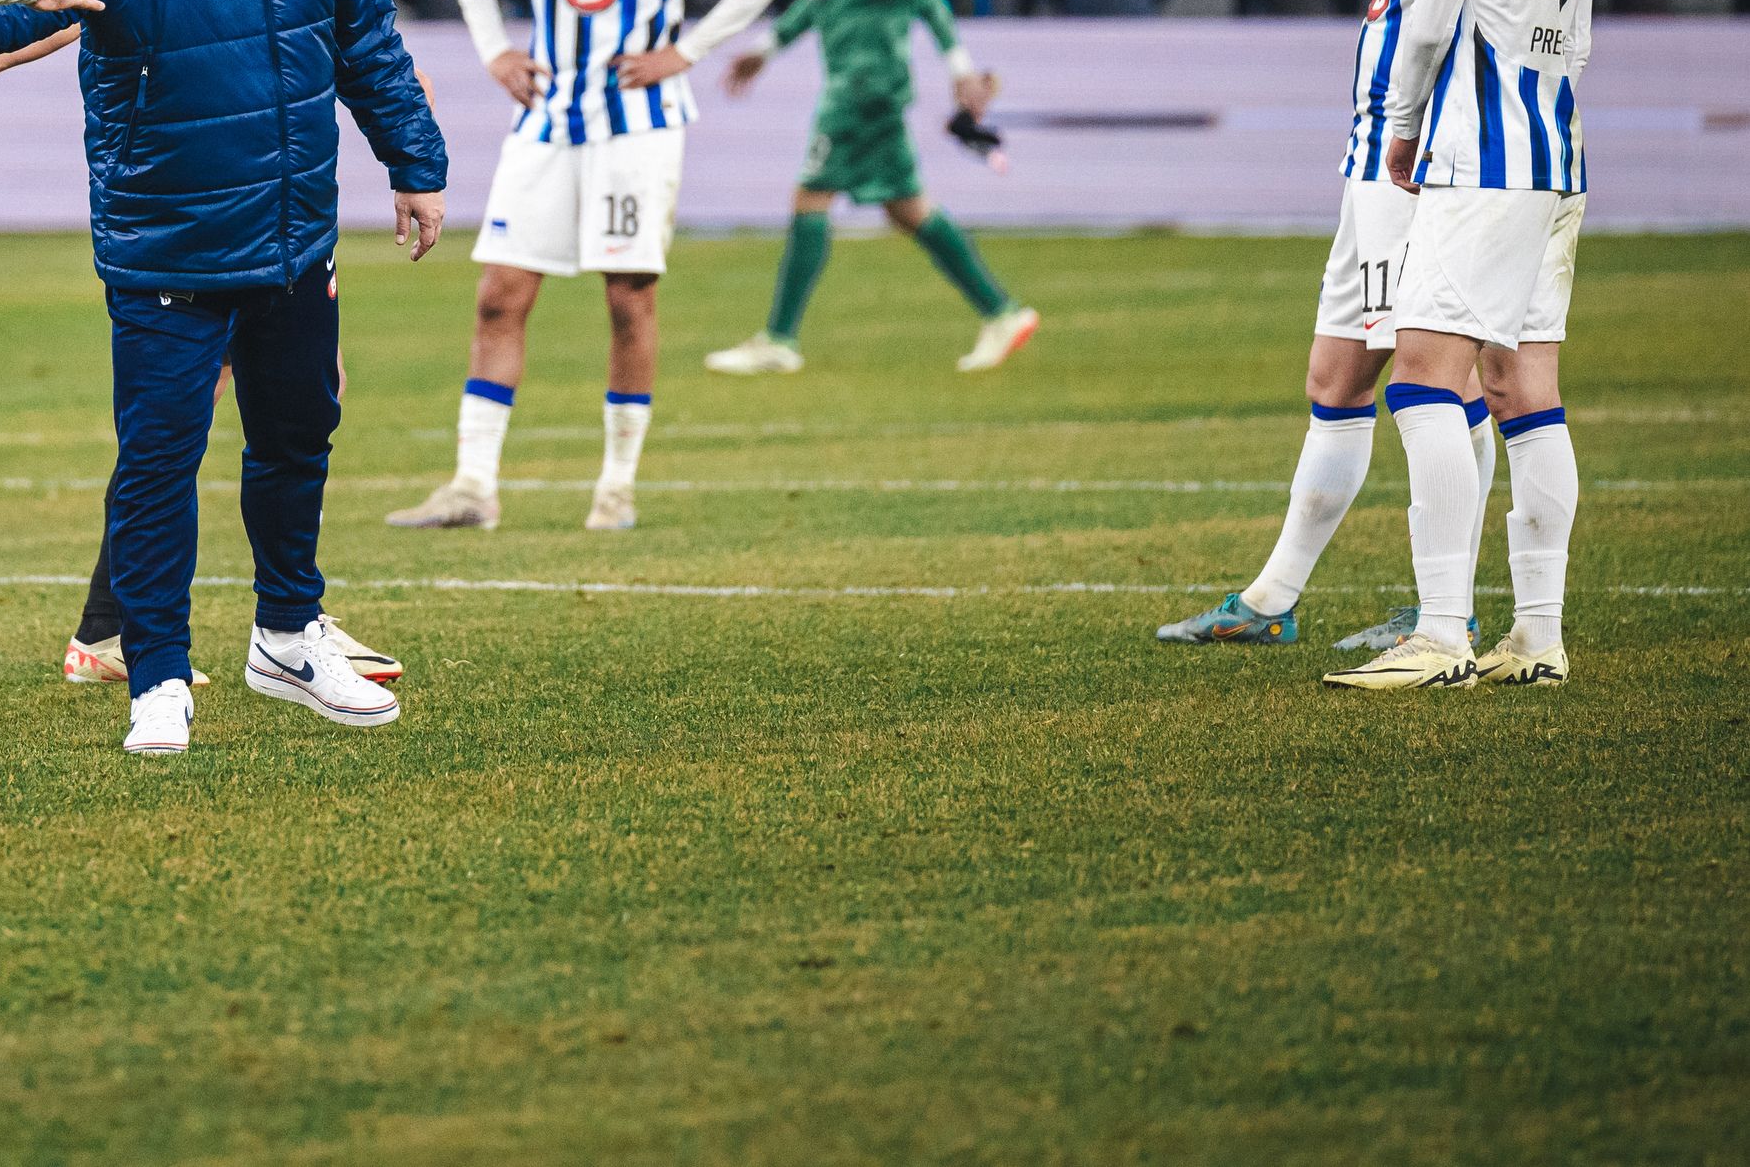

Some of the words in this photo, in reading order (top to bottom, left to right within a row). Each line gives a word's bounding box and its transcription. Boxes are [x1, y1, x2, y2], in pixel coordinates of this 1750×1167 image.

[1530, 26, 1565, 56] PRE
[604, 195, 639, 237] 18
[1359, 259, 1393, 313] 11
